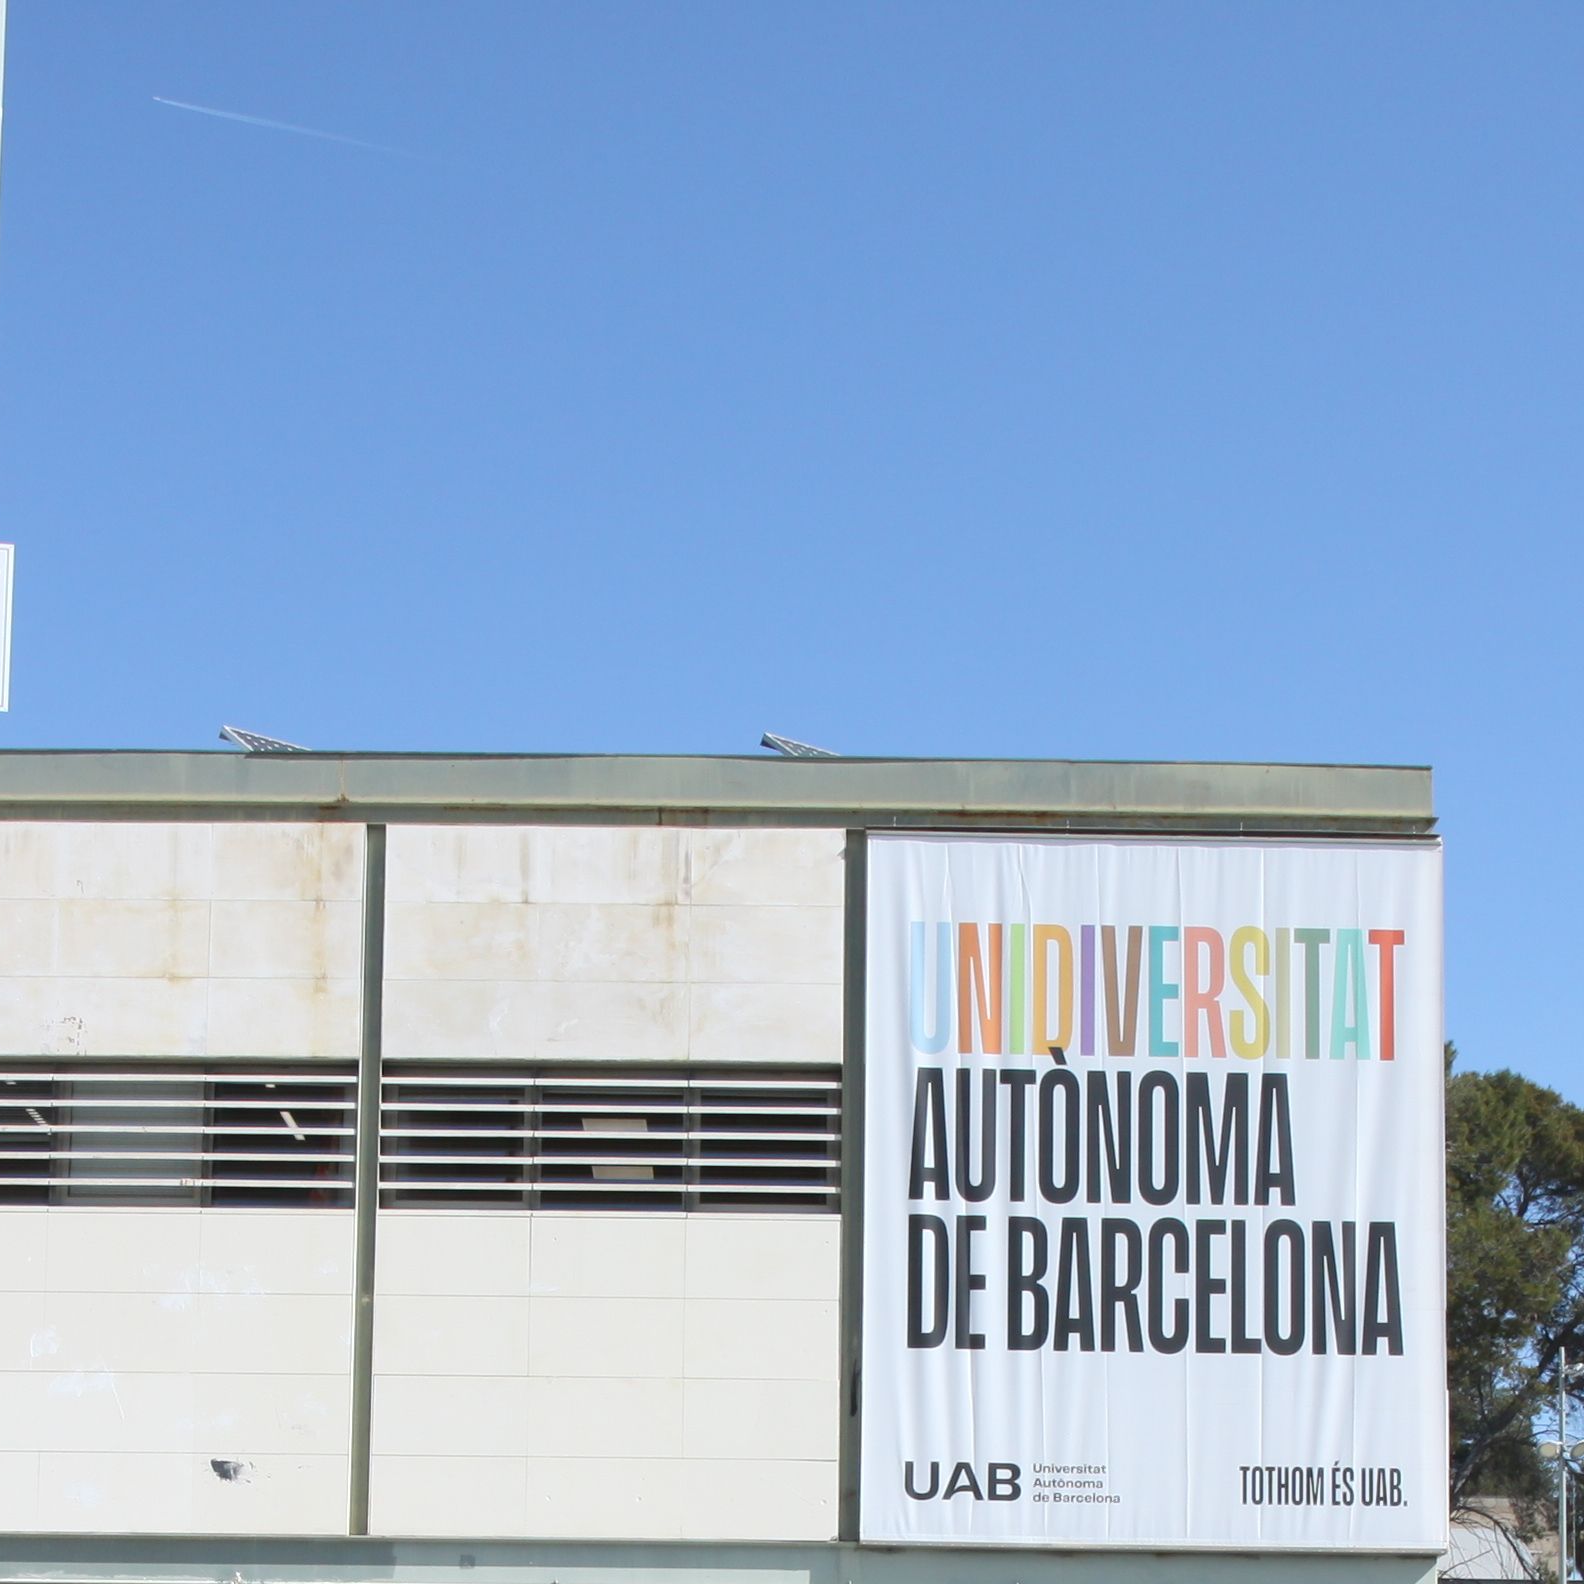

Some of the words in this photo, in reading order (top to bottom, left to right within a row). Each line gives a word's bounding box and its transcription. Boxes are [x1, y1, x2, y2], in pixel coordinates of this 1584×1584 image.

[908, 920, 1405, 1061] UNIDIVERSITAT
[908, 1046, 1296, 1206] AUTÒNOMA
[906, 1213, 987, 1350] DE
[1006, 1216, 1405, 1356] BARCELONA
[903, 1461, 1022, 1502] UAB
[1032, 1461, 1108, 1476] Universitat
[1032, 1477, 1105, 1490] Autònoma
[1239, 1465, 1326, 1507] TOTHOM
[1330, 1459, 1357, 1507] ÉS
[1361, 1467, 1409, 1508] UAB.
[1032, 1492, 1049, 1504] de
[1051, 1493, 1121, 1505] Barcelona
